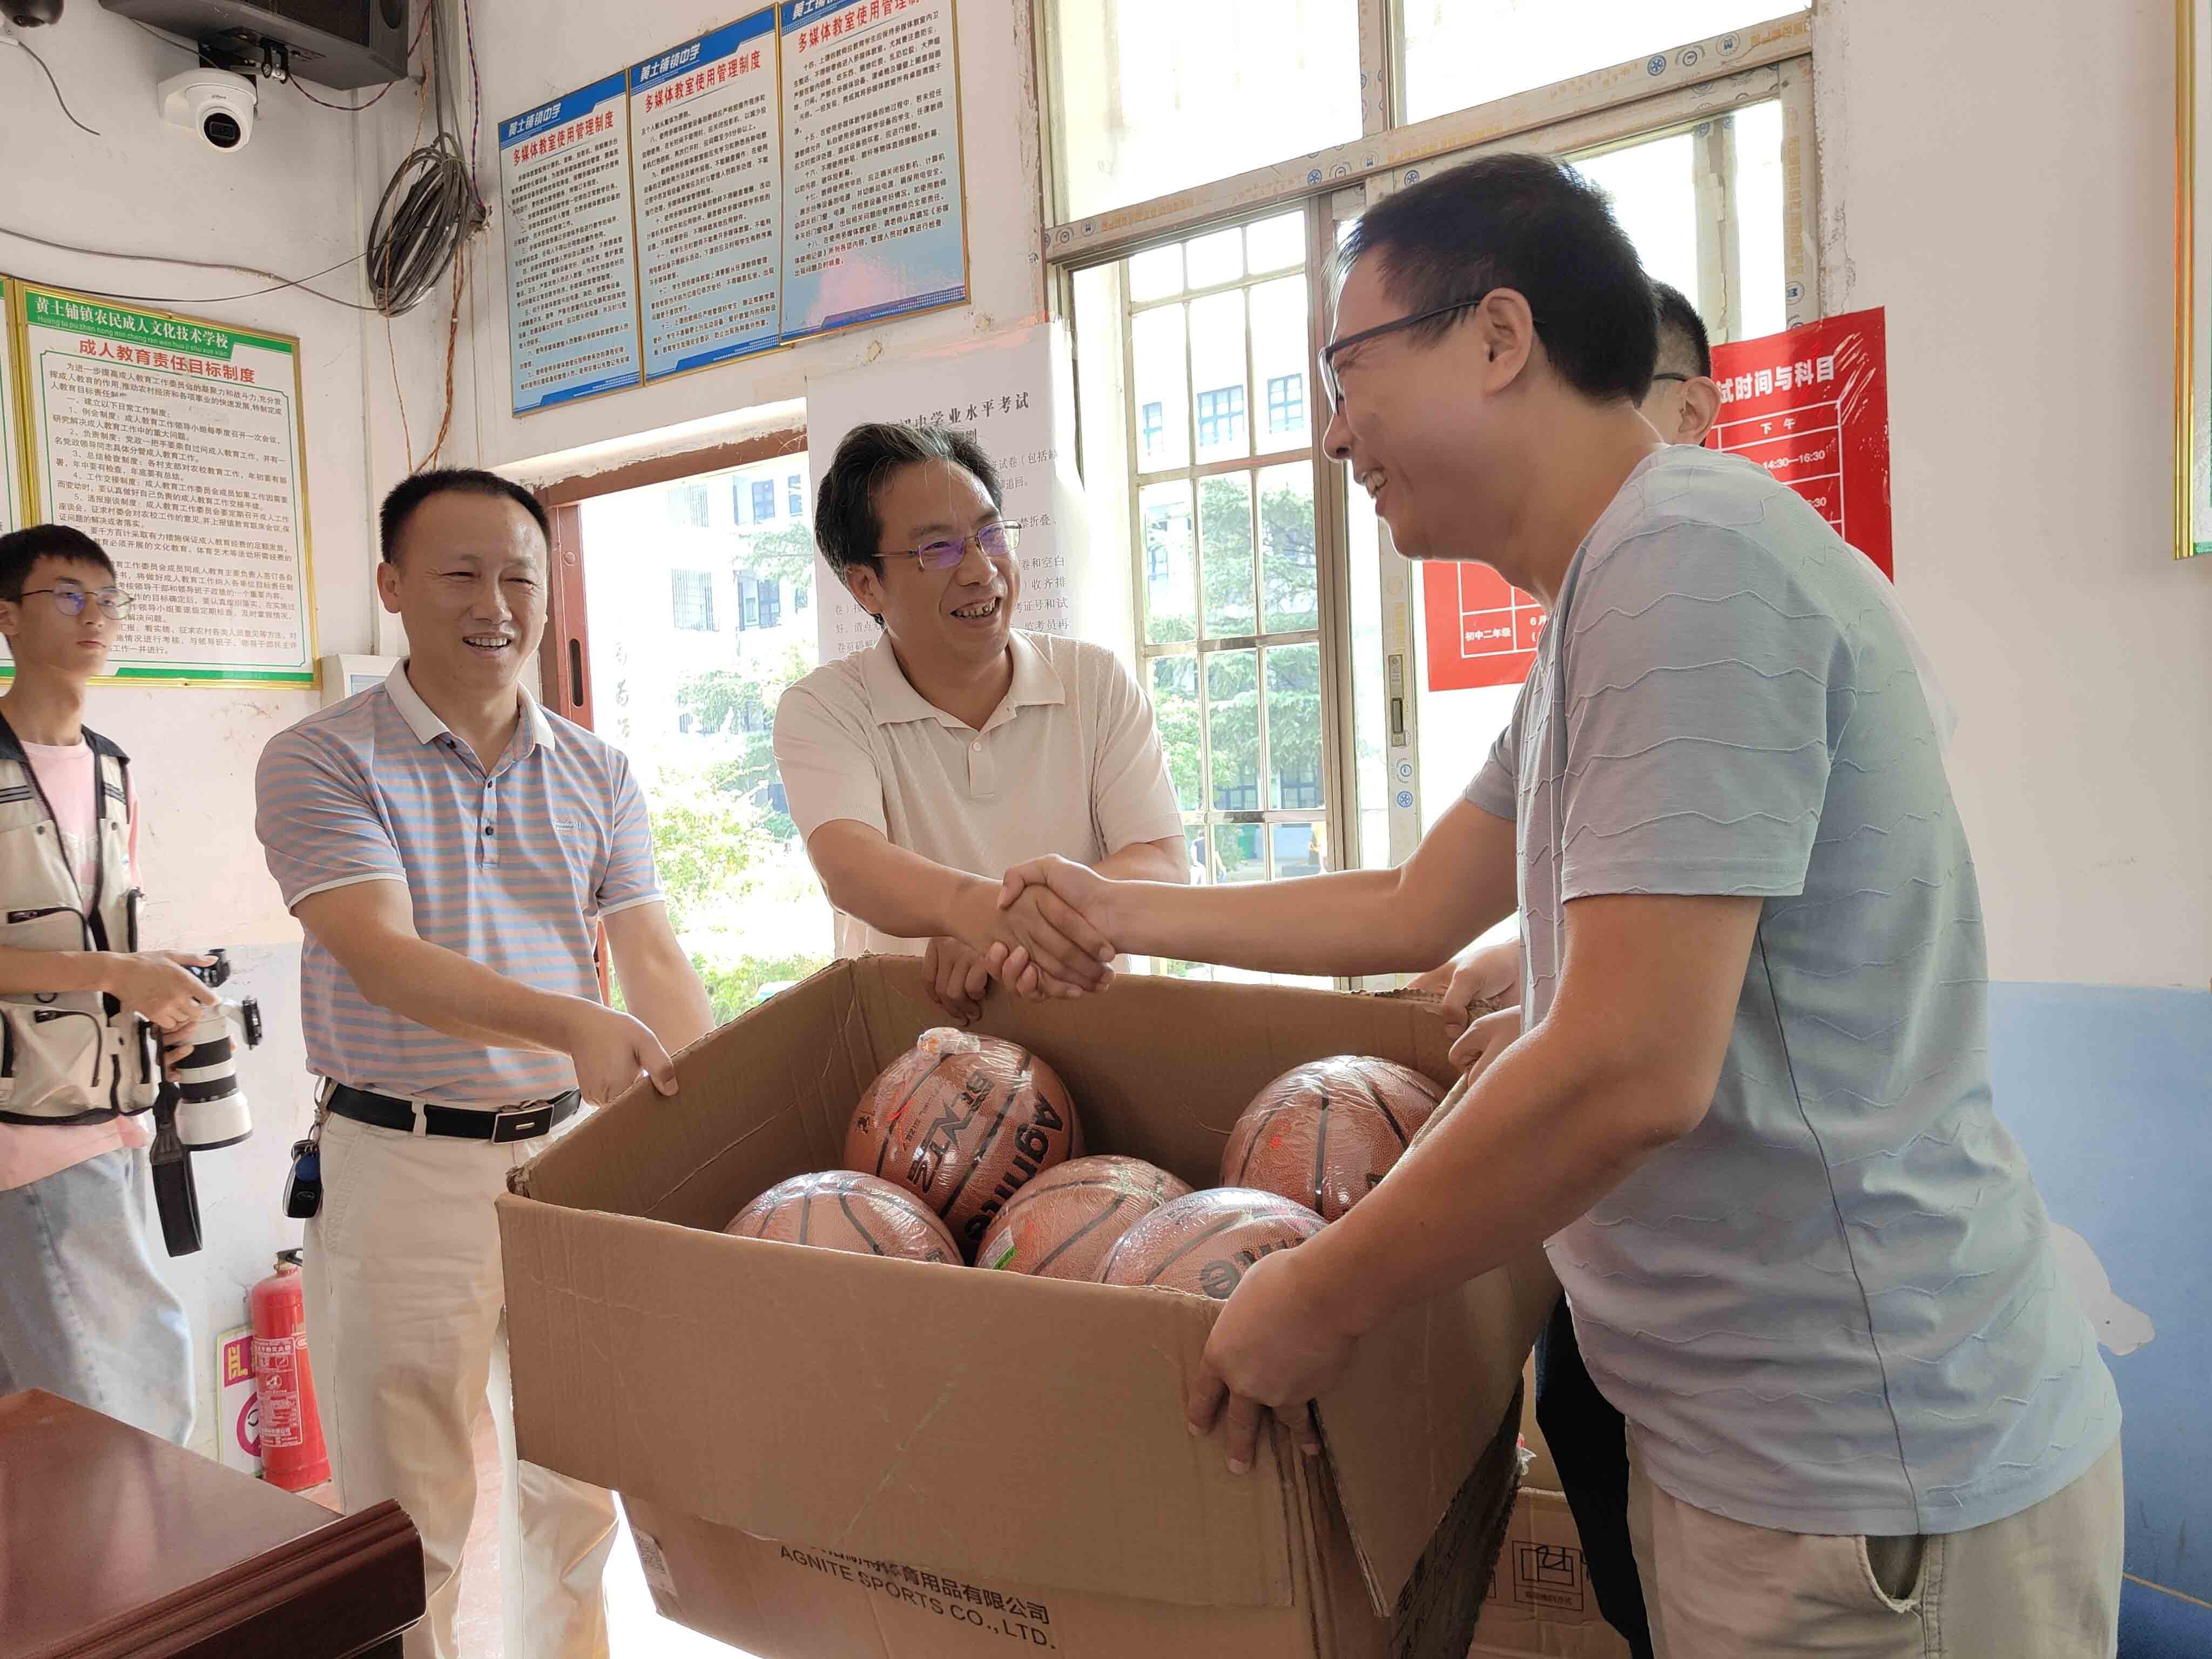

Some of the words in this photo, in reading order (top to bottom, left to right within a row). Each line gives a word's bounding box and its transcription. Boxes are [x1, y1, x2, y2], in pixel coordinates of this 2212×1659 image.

[799, 0, 922, 52] 多媒体教室使用管理
[645, 50, 760, 113] 多媒体教室使用管理制度
[513, 110, 613, 166] 多媒体教室使用管理制度
[36, 296, 227, 349] 黄土铺镇农民成人文化技术学校
[79, 339, 255, 384] 成人教育责任目标制度
[111, 644, 168, 655] 工作一并进行。
[781, 1546, 854, 1582] AGNITE
[858, 1570, 943, 1615] SPORTS
